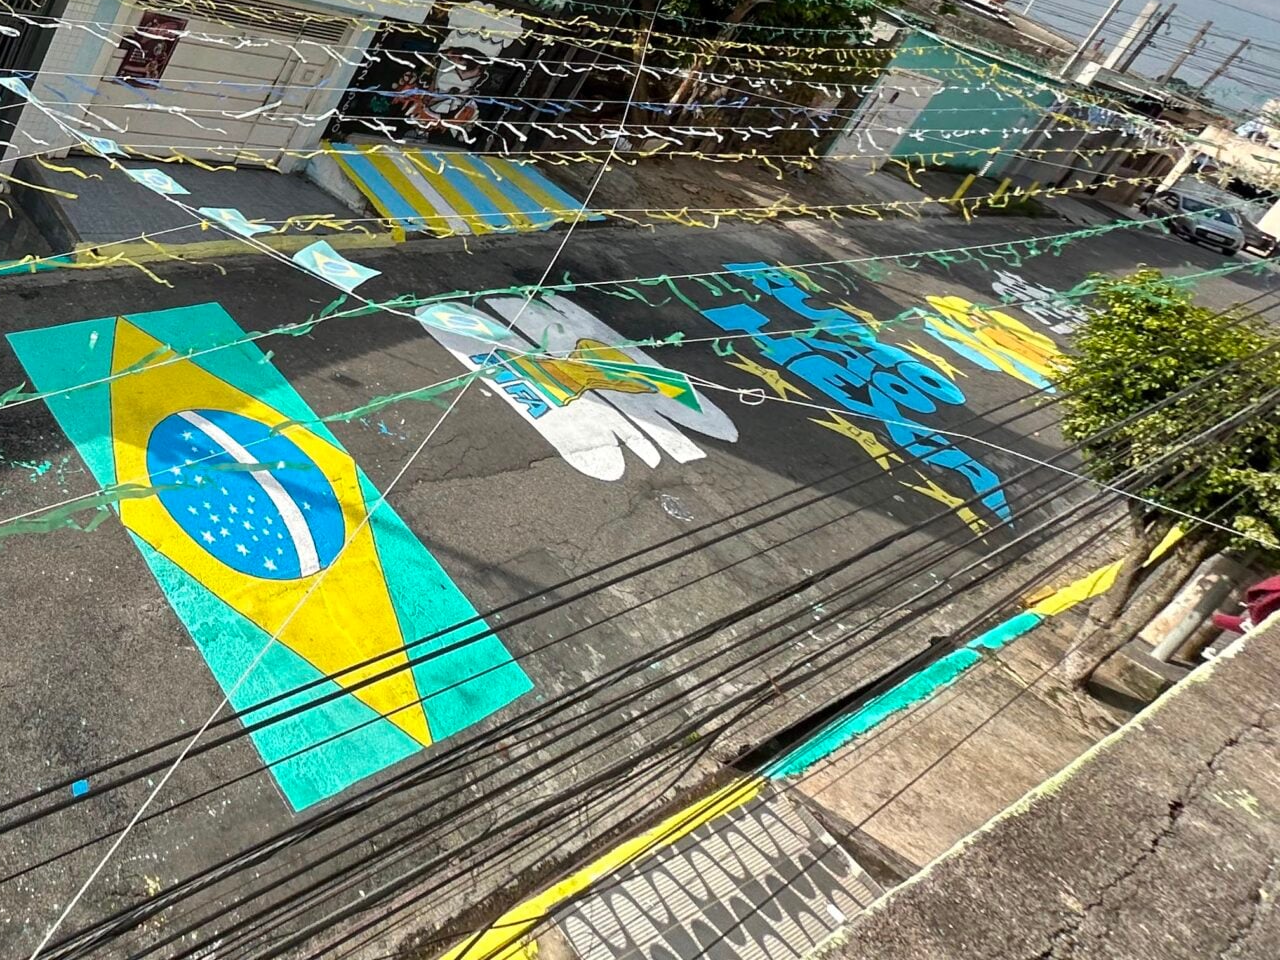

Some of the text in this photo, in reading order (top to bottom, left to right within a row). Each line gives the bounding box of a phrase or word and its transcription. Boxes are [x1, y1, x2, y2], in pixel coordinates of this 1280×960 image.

[722, 261, 967, 405] RUMO
[805, 336, 937, 414] AO
[699, 303, 1016, 530] HEXA
